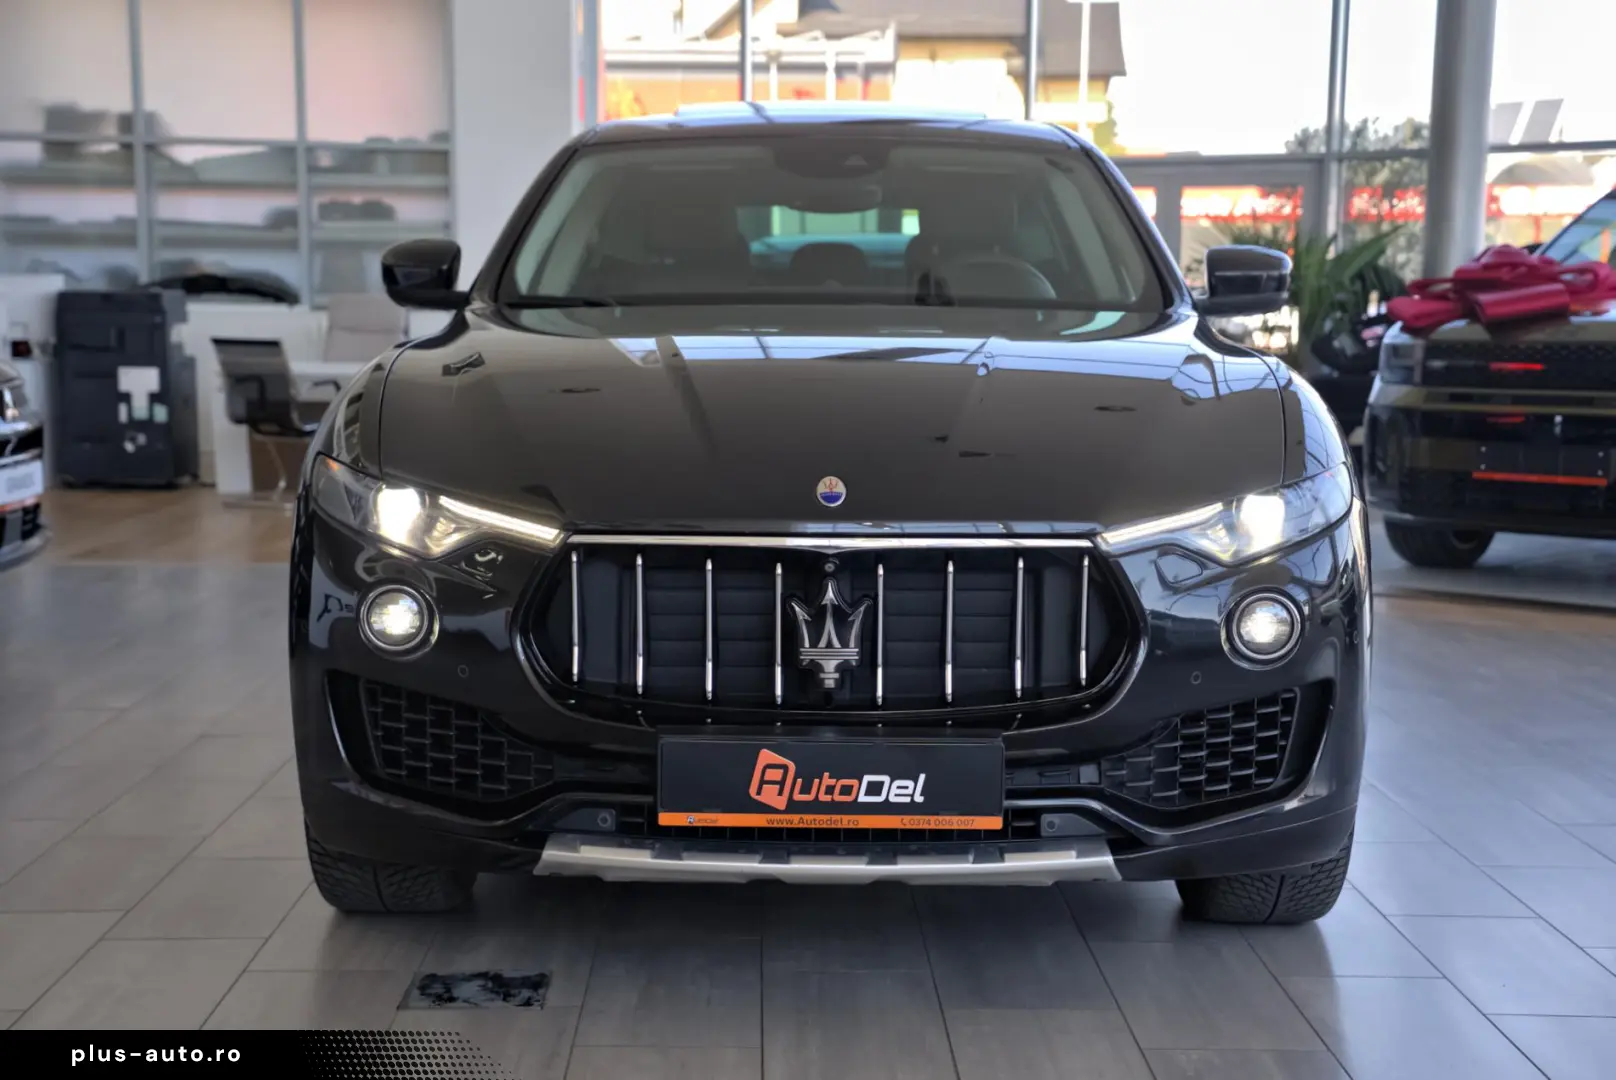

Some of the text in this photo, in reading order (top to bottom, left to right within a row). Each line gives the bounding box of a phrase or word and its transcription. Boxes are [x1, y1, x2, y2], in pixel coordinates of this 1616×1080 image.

[750, 751, 926, 809] AutoDel
[766, 817, 859, 827] www.Autodel.ro
[908, 818, 931, 827] 0374
